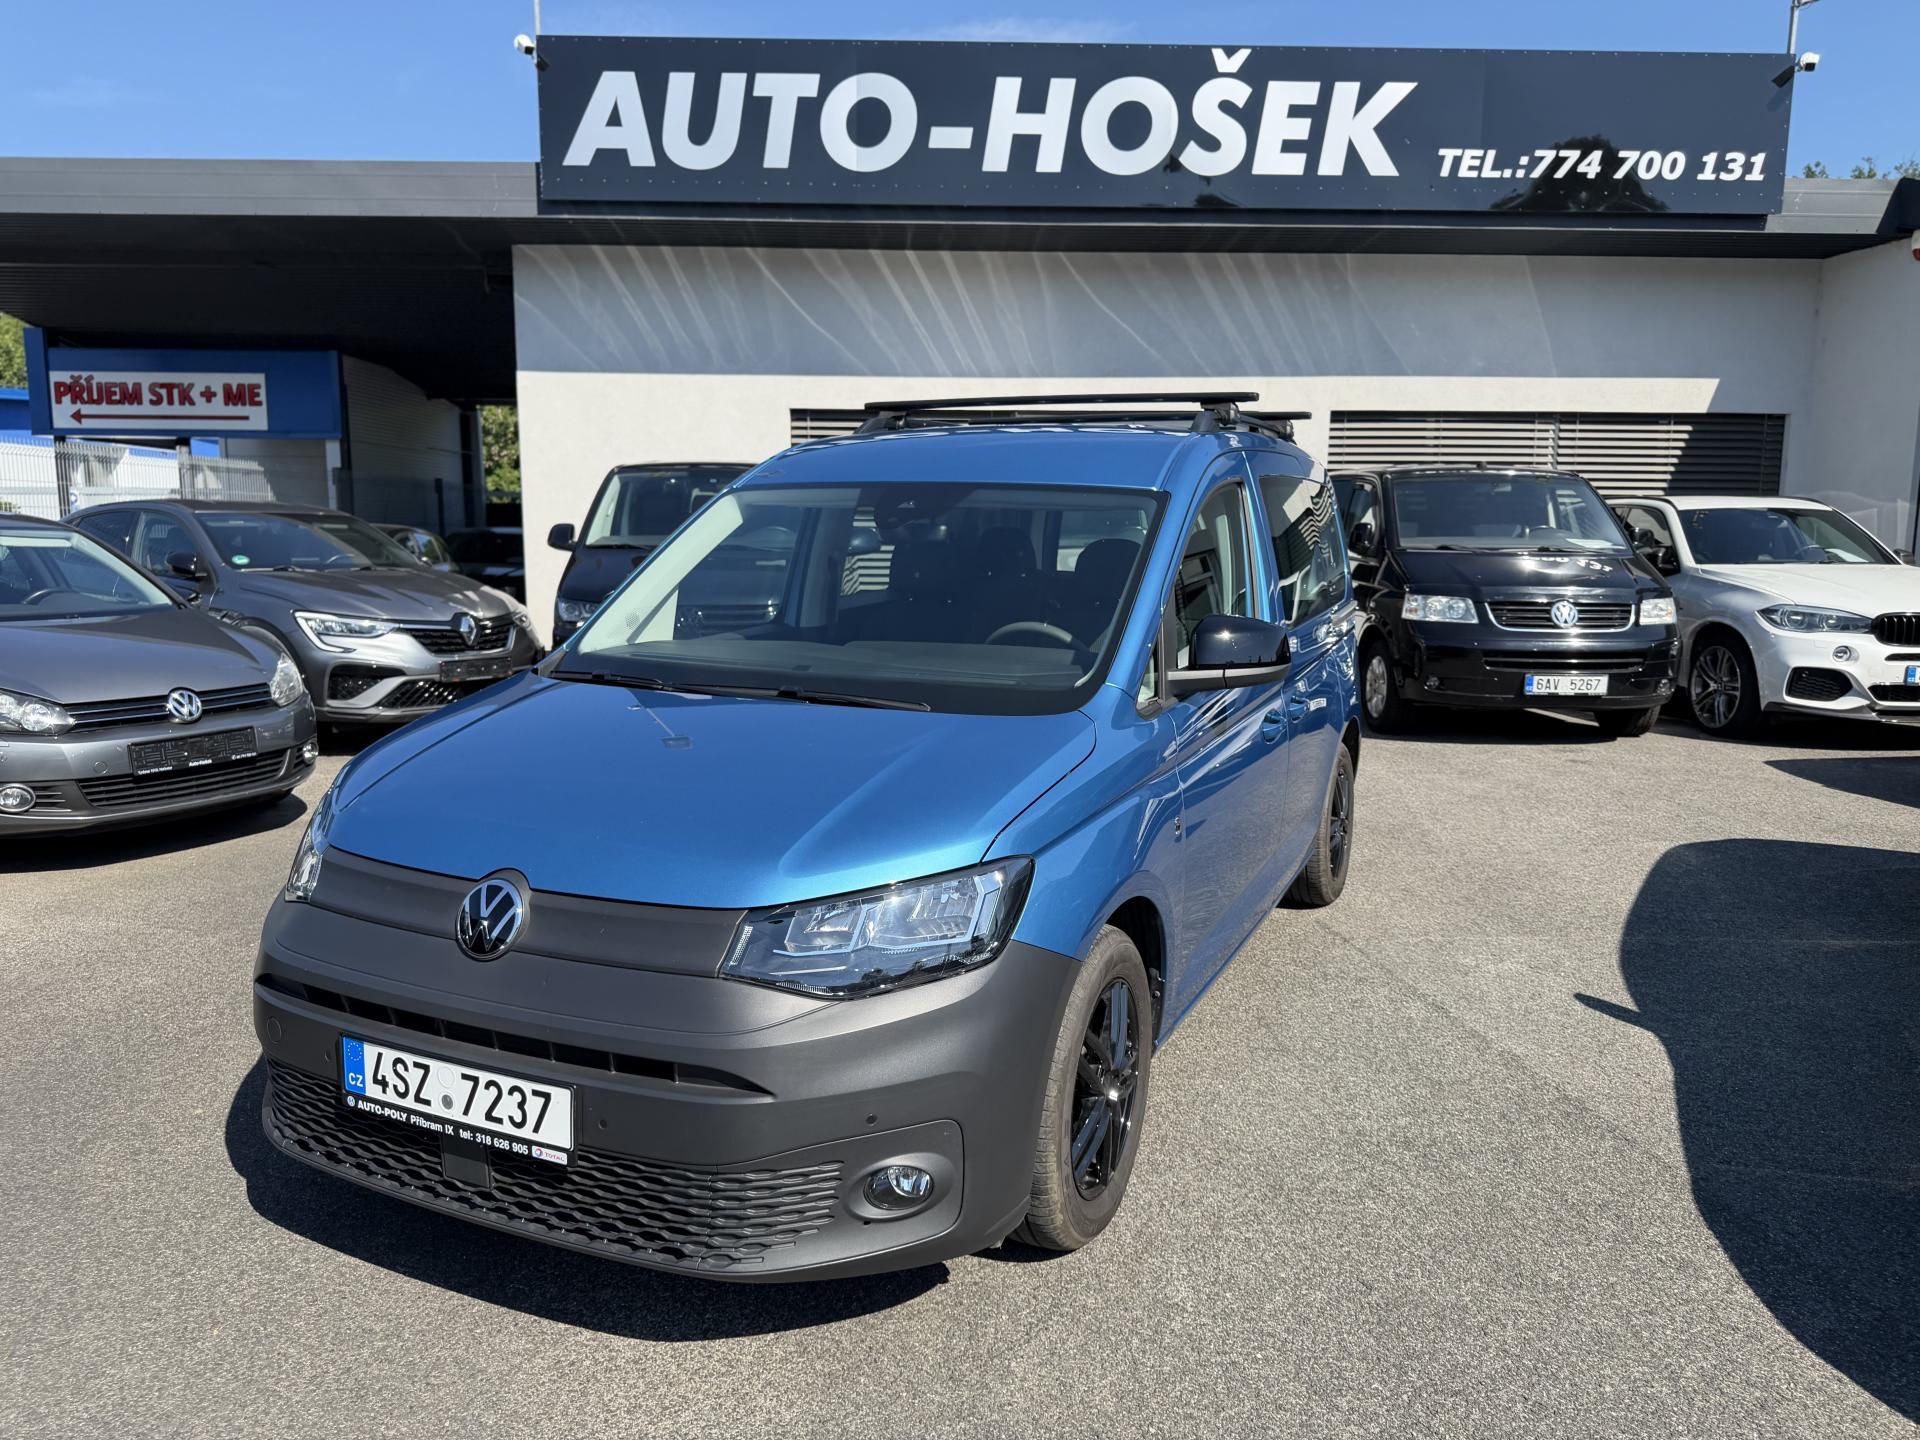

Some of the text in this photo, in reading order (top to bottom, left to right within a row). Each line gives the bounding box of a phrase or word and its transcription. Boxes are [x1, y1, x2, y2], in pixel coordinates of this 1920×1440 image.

[562, 47, 1419, 177] AUTO-HOŠEK
[1612, 150, 1687, 181] 700
[1696, 152, 1767, 182] 131
[54, 374, 263, 407] PŘÍJEM STK + ME
[1536, 678, 1601, 691] 6AV 5267
[349, 1072, 364, 1088] CZ
[372, 1051, 552, 1134] 4SZ 7237
[357, 1100, 408, 1122] AUTO-POLY
[445, 1124, 455, 1136] IX
[459, 1129, 474, 1141] tel:
[475, 1133, 492, 1146] 318
[494, 1139, 510, 1151] 626
[511, 1142, 529, 1155] 905
[544, 1151, 565, 1162] TOTAL
